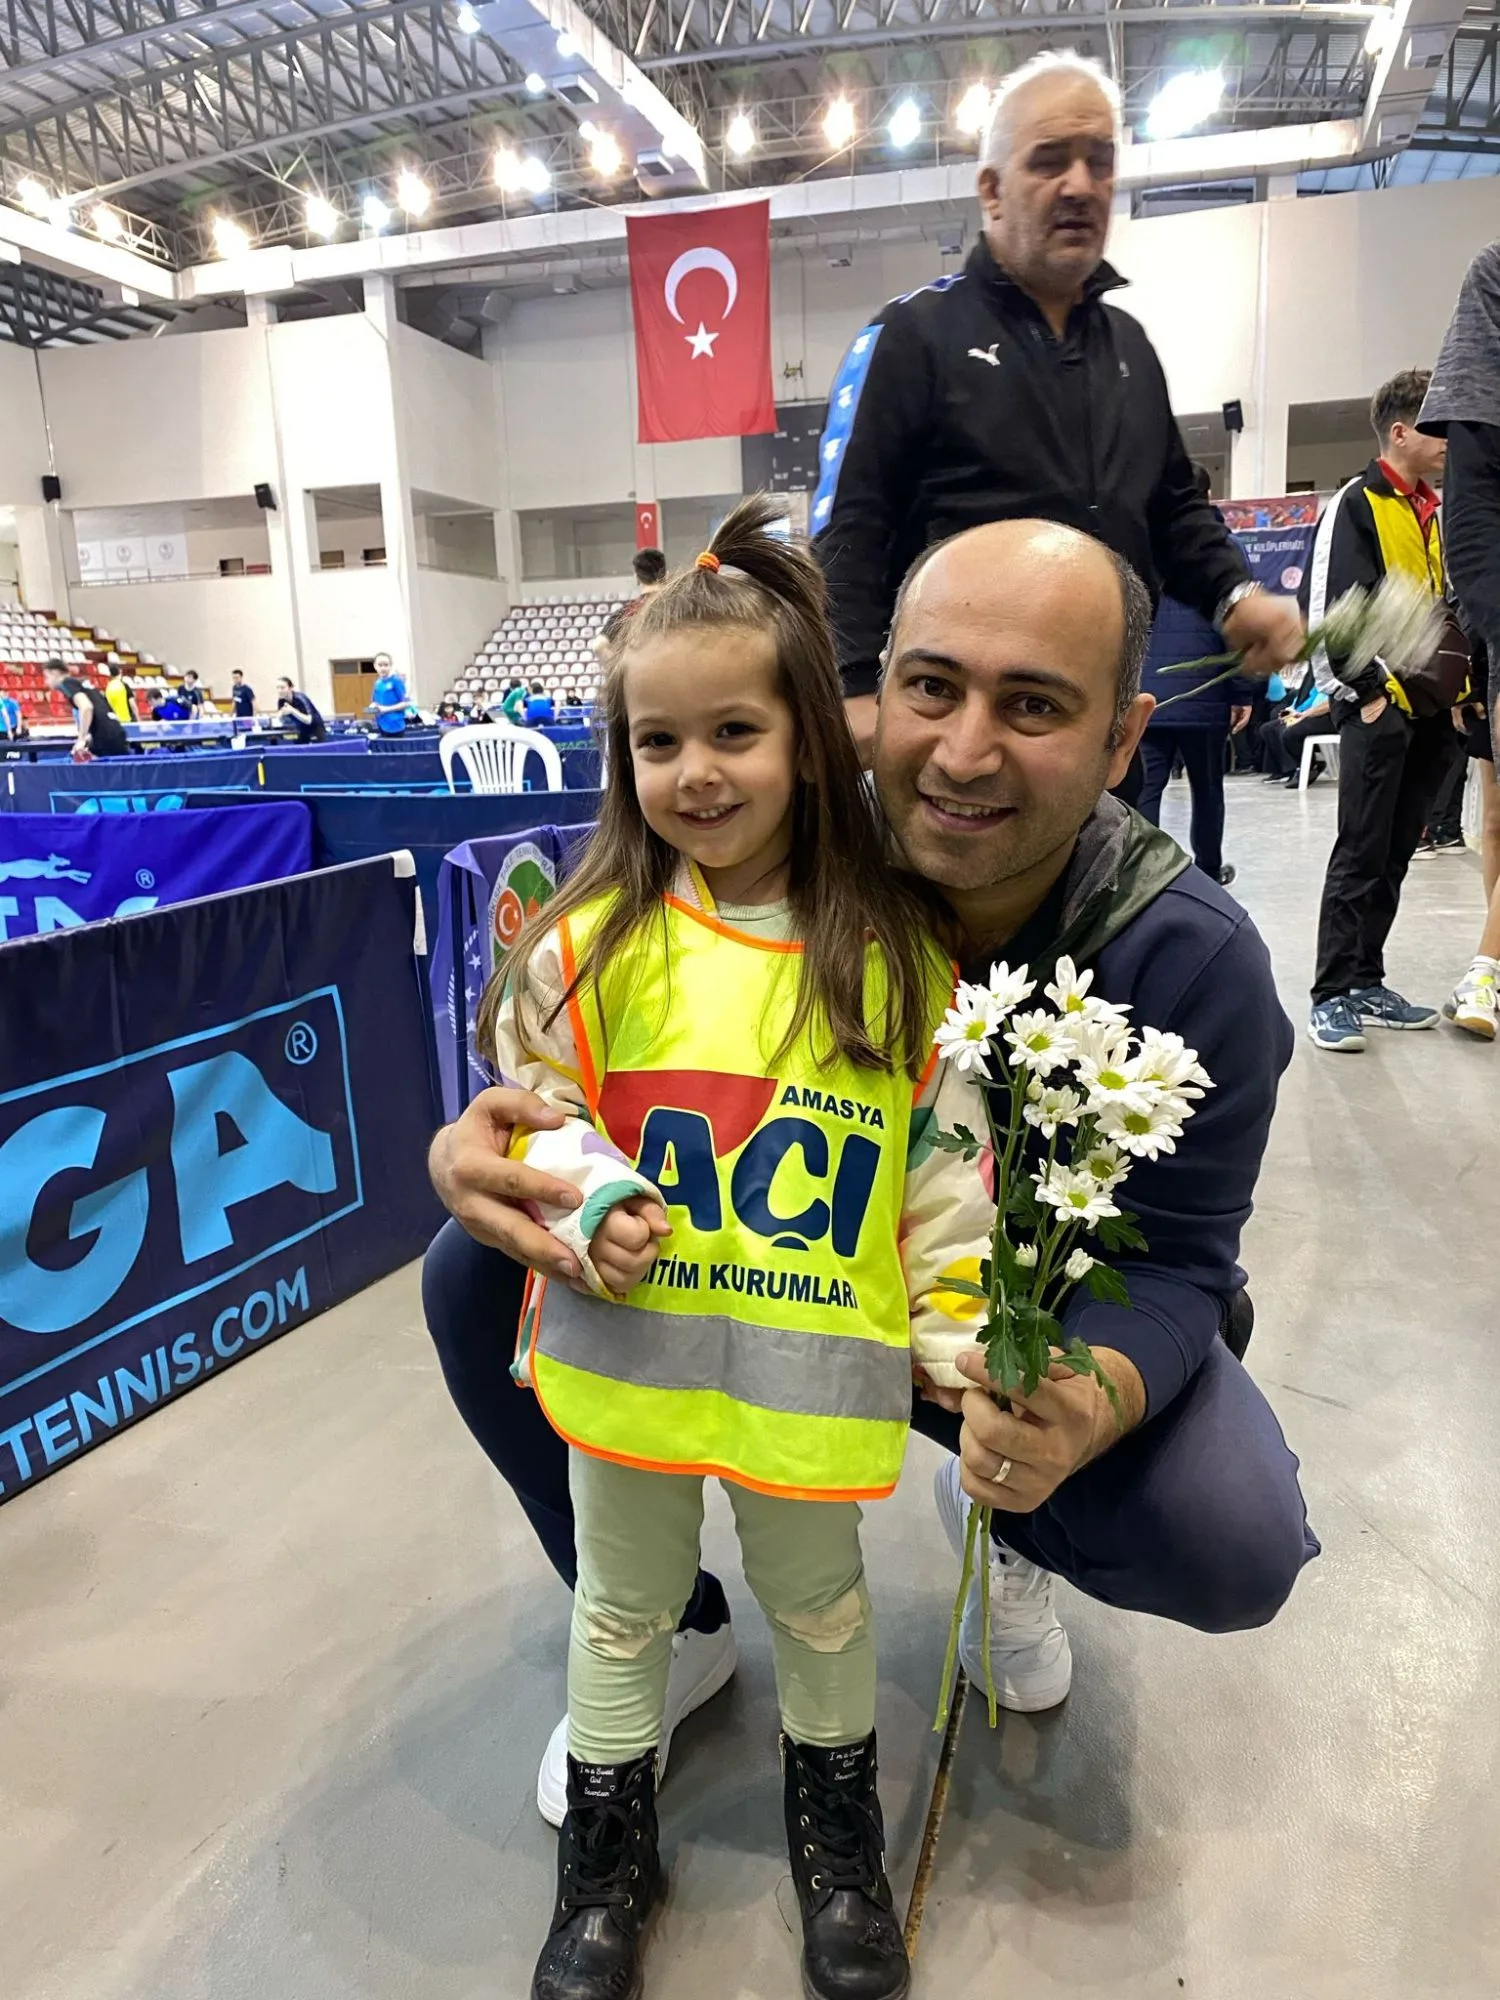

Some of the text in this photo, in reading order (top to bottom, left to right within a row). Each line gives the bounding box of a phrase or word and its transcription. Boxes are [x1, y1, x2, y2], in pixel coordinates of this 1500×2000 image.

[780, 1085, 885, 1129] AMASYA
[634, 1107, 882, 1258] AÇI
[709, 1263, 858, 1310] KURUMLARI
[0, 1266, 310, 1495] TENNIS.COM
